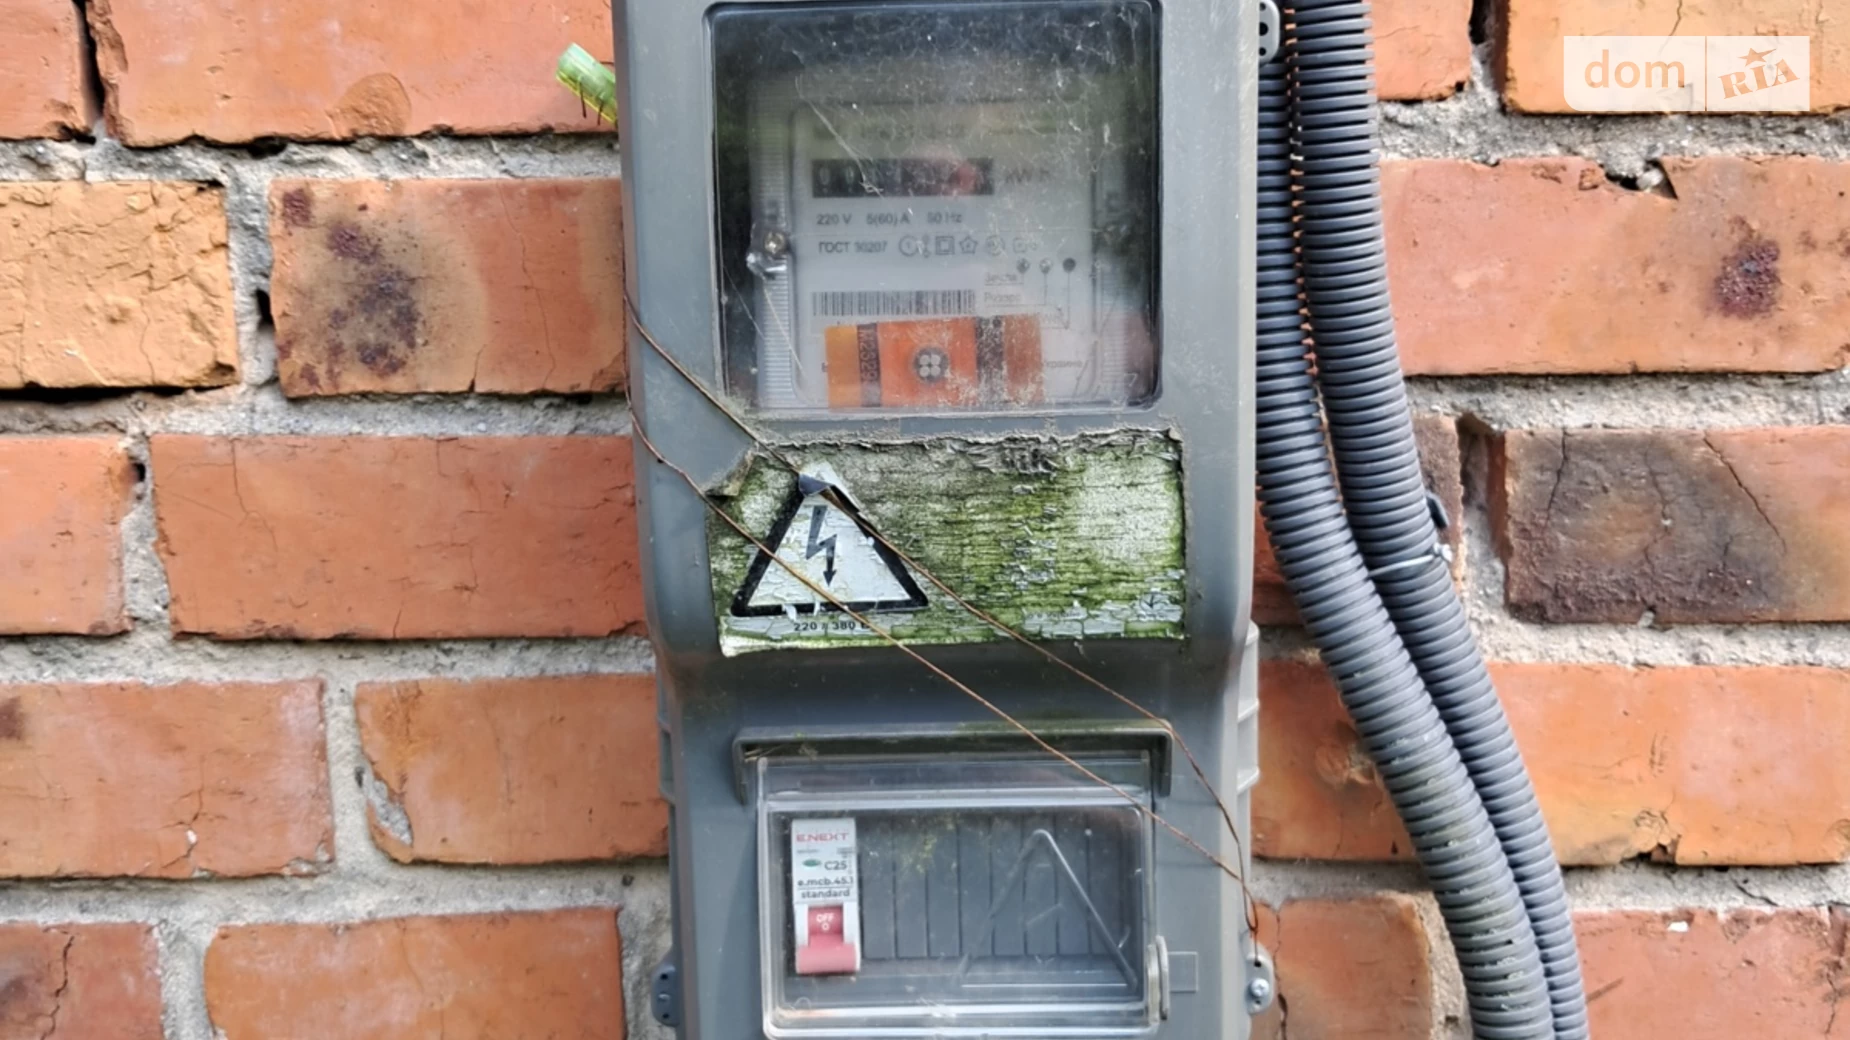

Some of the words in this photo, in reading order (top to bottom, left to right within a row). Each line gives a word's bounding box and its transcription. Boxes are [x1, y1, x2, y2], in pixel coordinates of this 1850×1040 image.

[816, 212, 840, 226] 220
[842, 212, 853, 225] V
[866, 212, 898, 227] 5(60)
[927, 211, 943, 225] 50
[945, 211, 963, 224] Hz
[818, 241, 850, 254] ГОСТ
[794, 621, 818, 632] 220
[832, 621, 857, 631] 380
[824, 860, 848, 871] C25
[801, 888, 850, 899] standard
[816, 913, 835, 923] OFF
